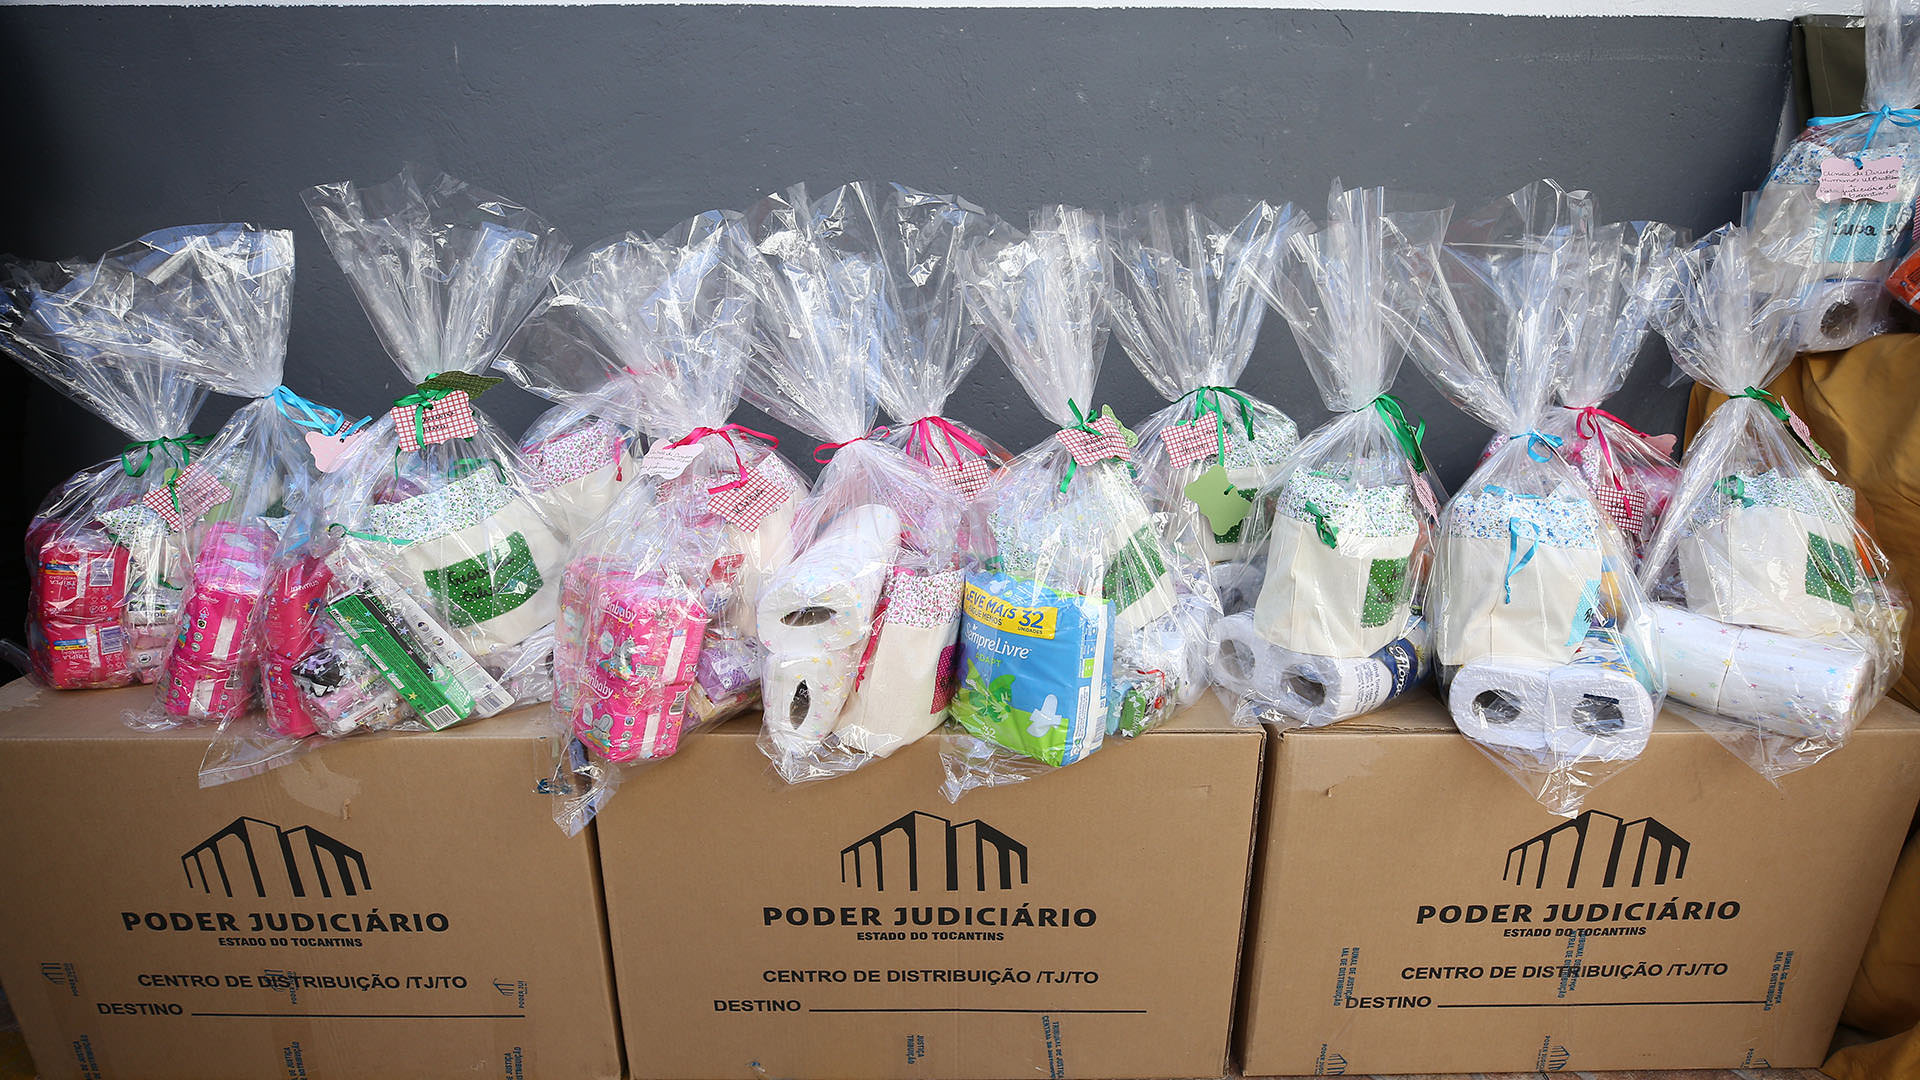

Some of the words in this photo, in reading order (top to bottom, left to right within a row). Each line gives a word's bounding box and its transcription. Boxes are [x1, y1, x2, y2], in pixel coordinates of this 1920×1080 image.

[982, 611, 1003, 627] MENOS
[986, 595, 1017, 620] MAIS
[1018, 609, 1045, 630] 32
[1017, 625, 1043, 636] UNIDADES
[764, 907, 882, 925] PODER
[895, 903, 1096, 927] JUDICIÁRIO
[1416, 904, 1530, 924] PODER
[1543, 897, 1740, 922] JUDICIÁRIO
[121, 912, 240, 931] PODER
[248, 908, 448, 932] JUDICIÁRIO
[857, 932, 905, 940] ESTADO
[911, 932, 927, 940] DO
[932, 932, 1004, 940] TOCANTINS
[1504, 929, 1551, 937] ESTADO
[1554, 928, 1575, 937] DO
[1576, 926, 1646, 937] TOCANTINS
[218, 937, 266, 947] ESTADO
[270, 938, 288, 946] DO
[293, 938, 362, 947] TOCANTINS
[763, 971, 846, 982] CENTRO
[854, 971, 880, 982] DE
[888, 968, 1030, 985] DISTRIBUIÇÃO
[1037, 971, 1098, 983] /TJ/TO
[1402, 967, 1483, 979] CENTRO
[1490, 967, 1517, 978] DE
[1523, 962, 1660, 981] DISTRIBUIÇÃO
[1667, 963, 1728, 976] /TJ/TO
[138, 975, 219, 987] CENTRO
[225, 976, 253, 987] DE
[257, 973, 399, 992] DISTRIBUIÇÃO
[407, 976, 467, 988] /TJ/TO
[97, 1003, 183, 1015] DESTINO
[714, 1000, 800, 1011] DESTINO
[1344, 996, 1431, 1008] DESTINO
